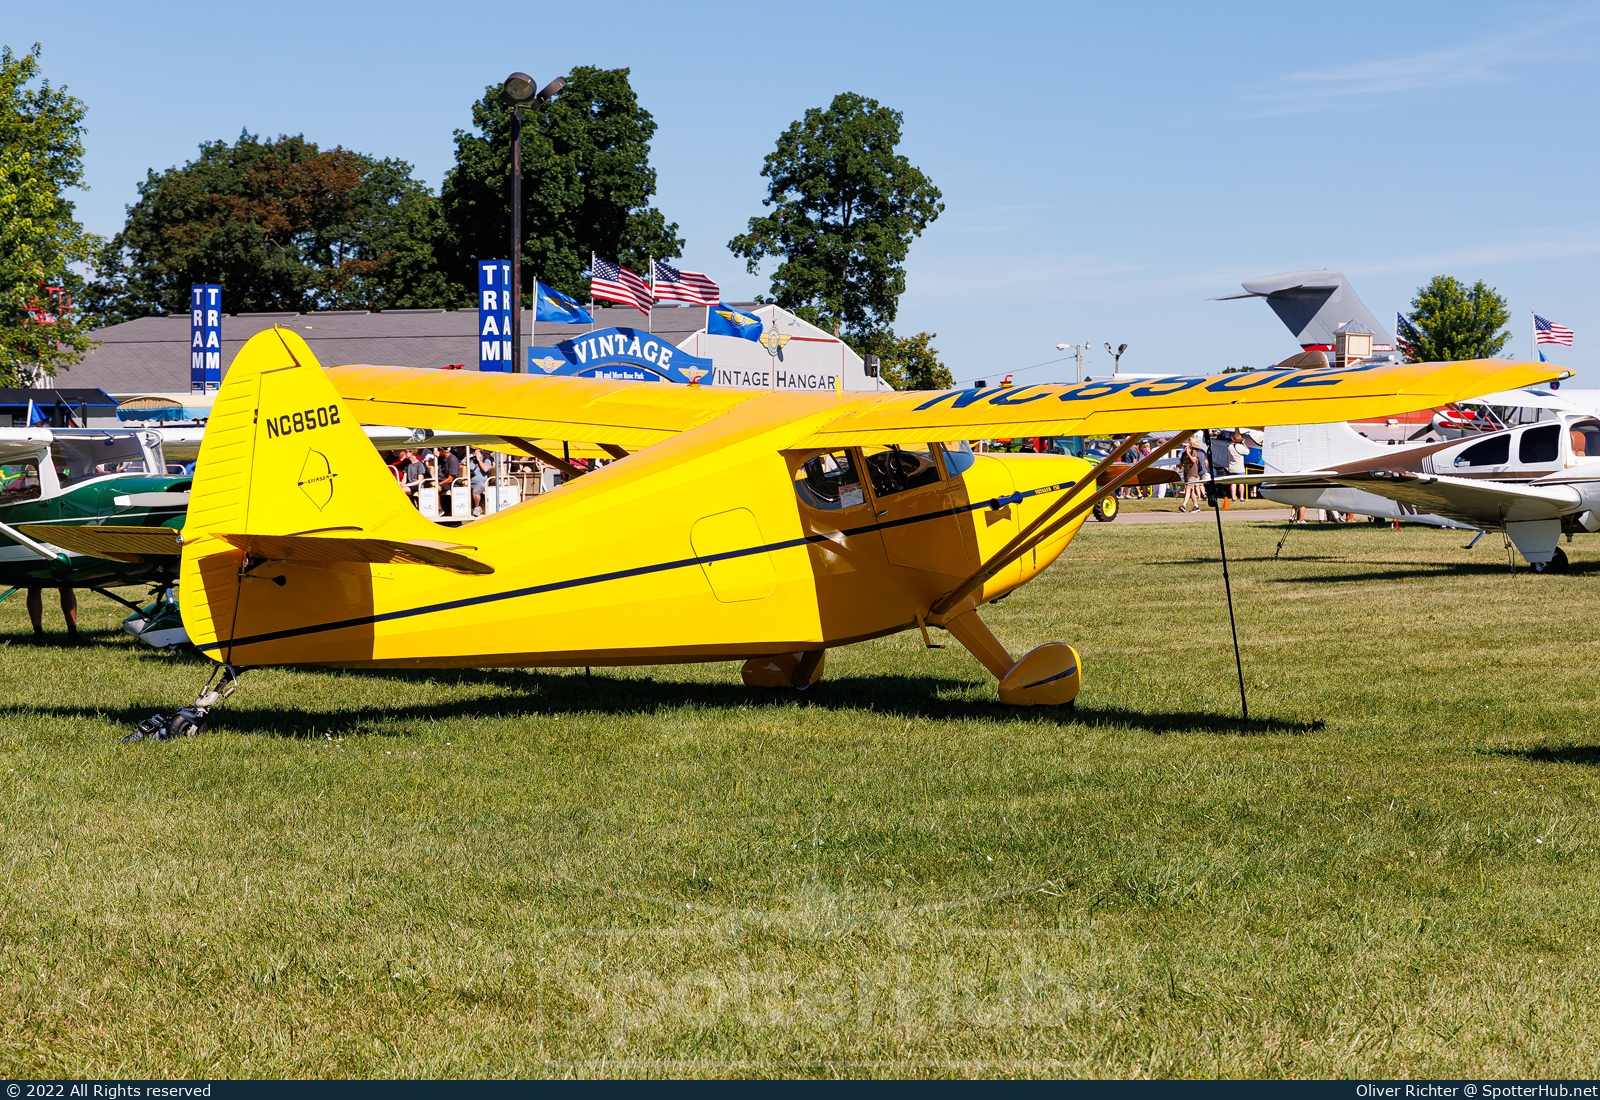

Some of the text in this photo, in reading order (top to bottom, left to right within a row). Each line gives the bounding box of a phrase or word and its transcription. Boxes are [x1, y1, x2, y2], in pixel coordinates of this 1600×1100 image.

[192, 288, 204, 369] TRAM
[206, 288, 220, 370] TRAM
[481, 264, 500, 361] TRAM
[502, 264, 512, 361] TRAM
[573, 333, 674, 371] VINTAGE
[634, 372, 645, 380] Park
[776, 370, 836, 390] HANGAR
[266, 404, 341, 439] NC8502
